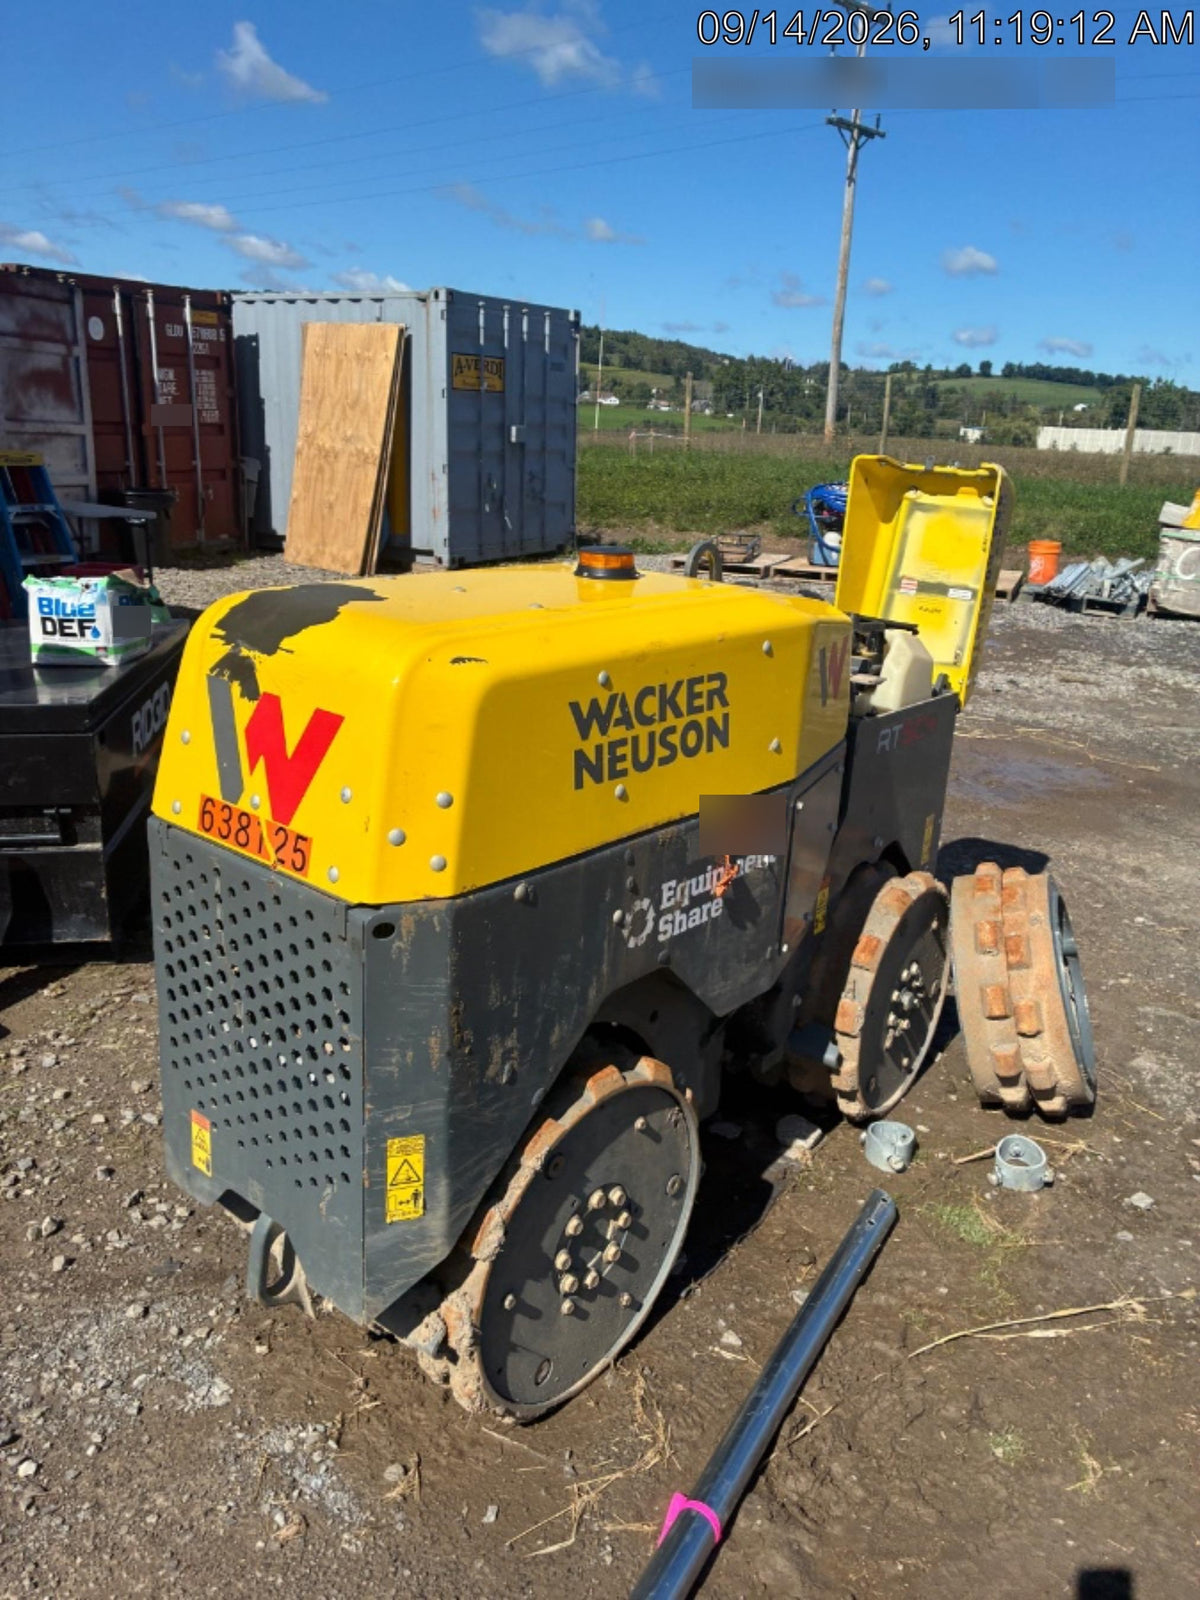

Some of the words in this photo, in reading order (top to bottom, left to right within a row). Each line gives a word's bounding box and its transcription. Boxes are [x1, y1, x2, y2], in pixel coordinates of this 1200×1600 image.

[37, 596, 96, 618] Blue
[40, 616, 97, 638] DEF
[568, 671, 730, 741] WACKER
[574, 713, 730, 790] NEUSON
[657, 896, 724, 942] Share
